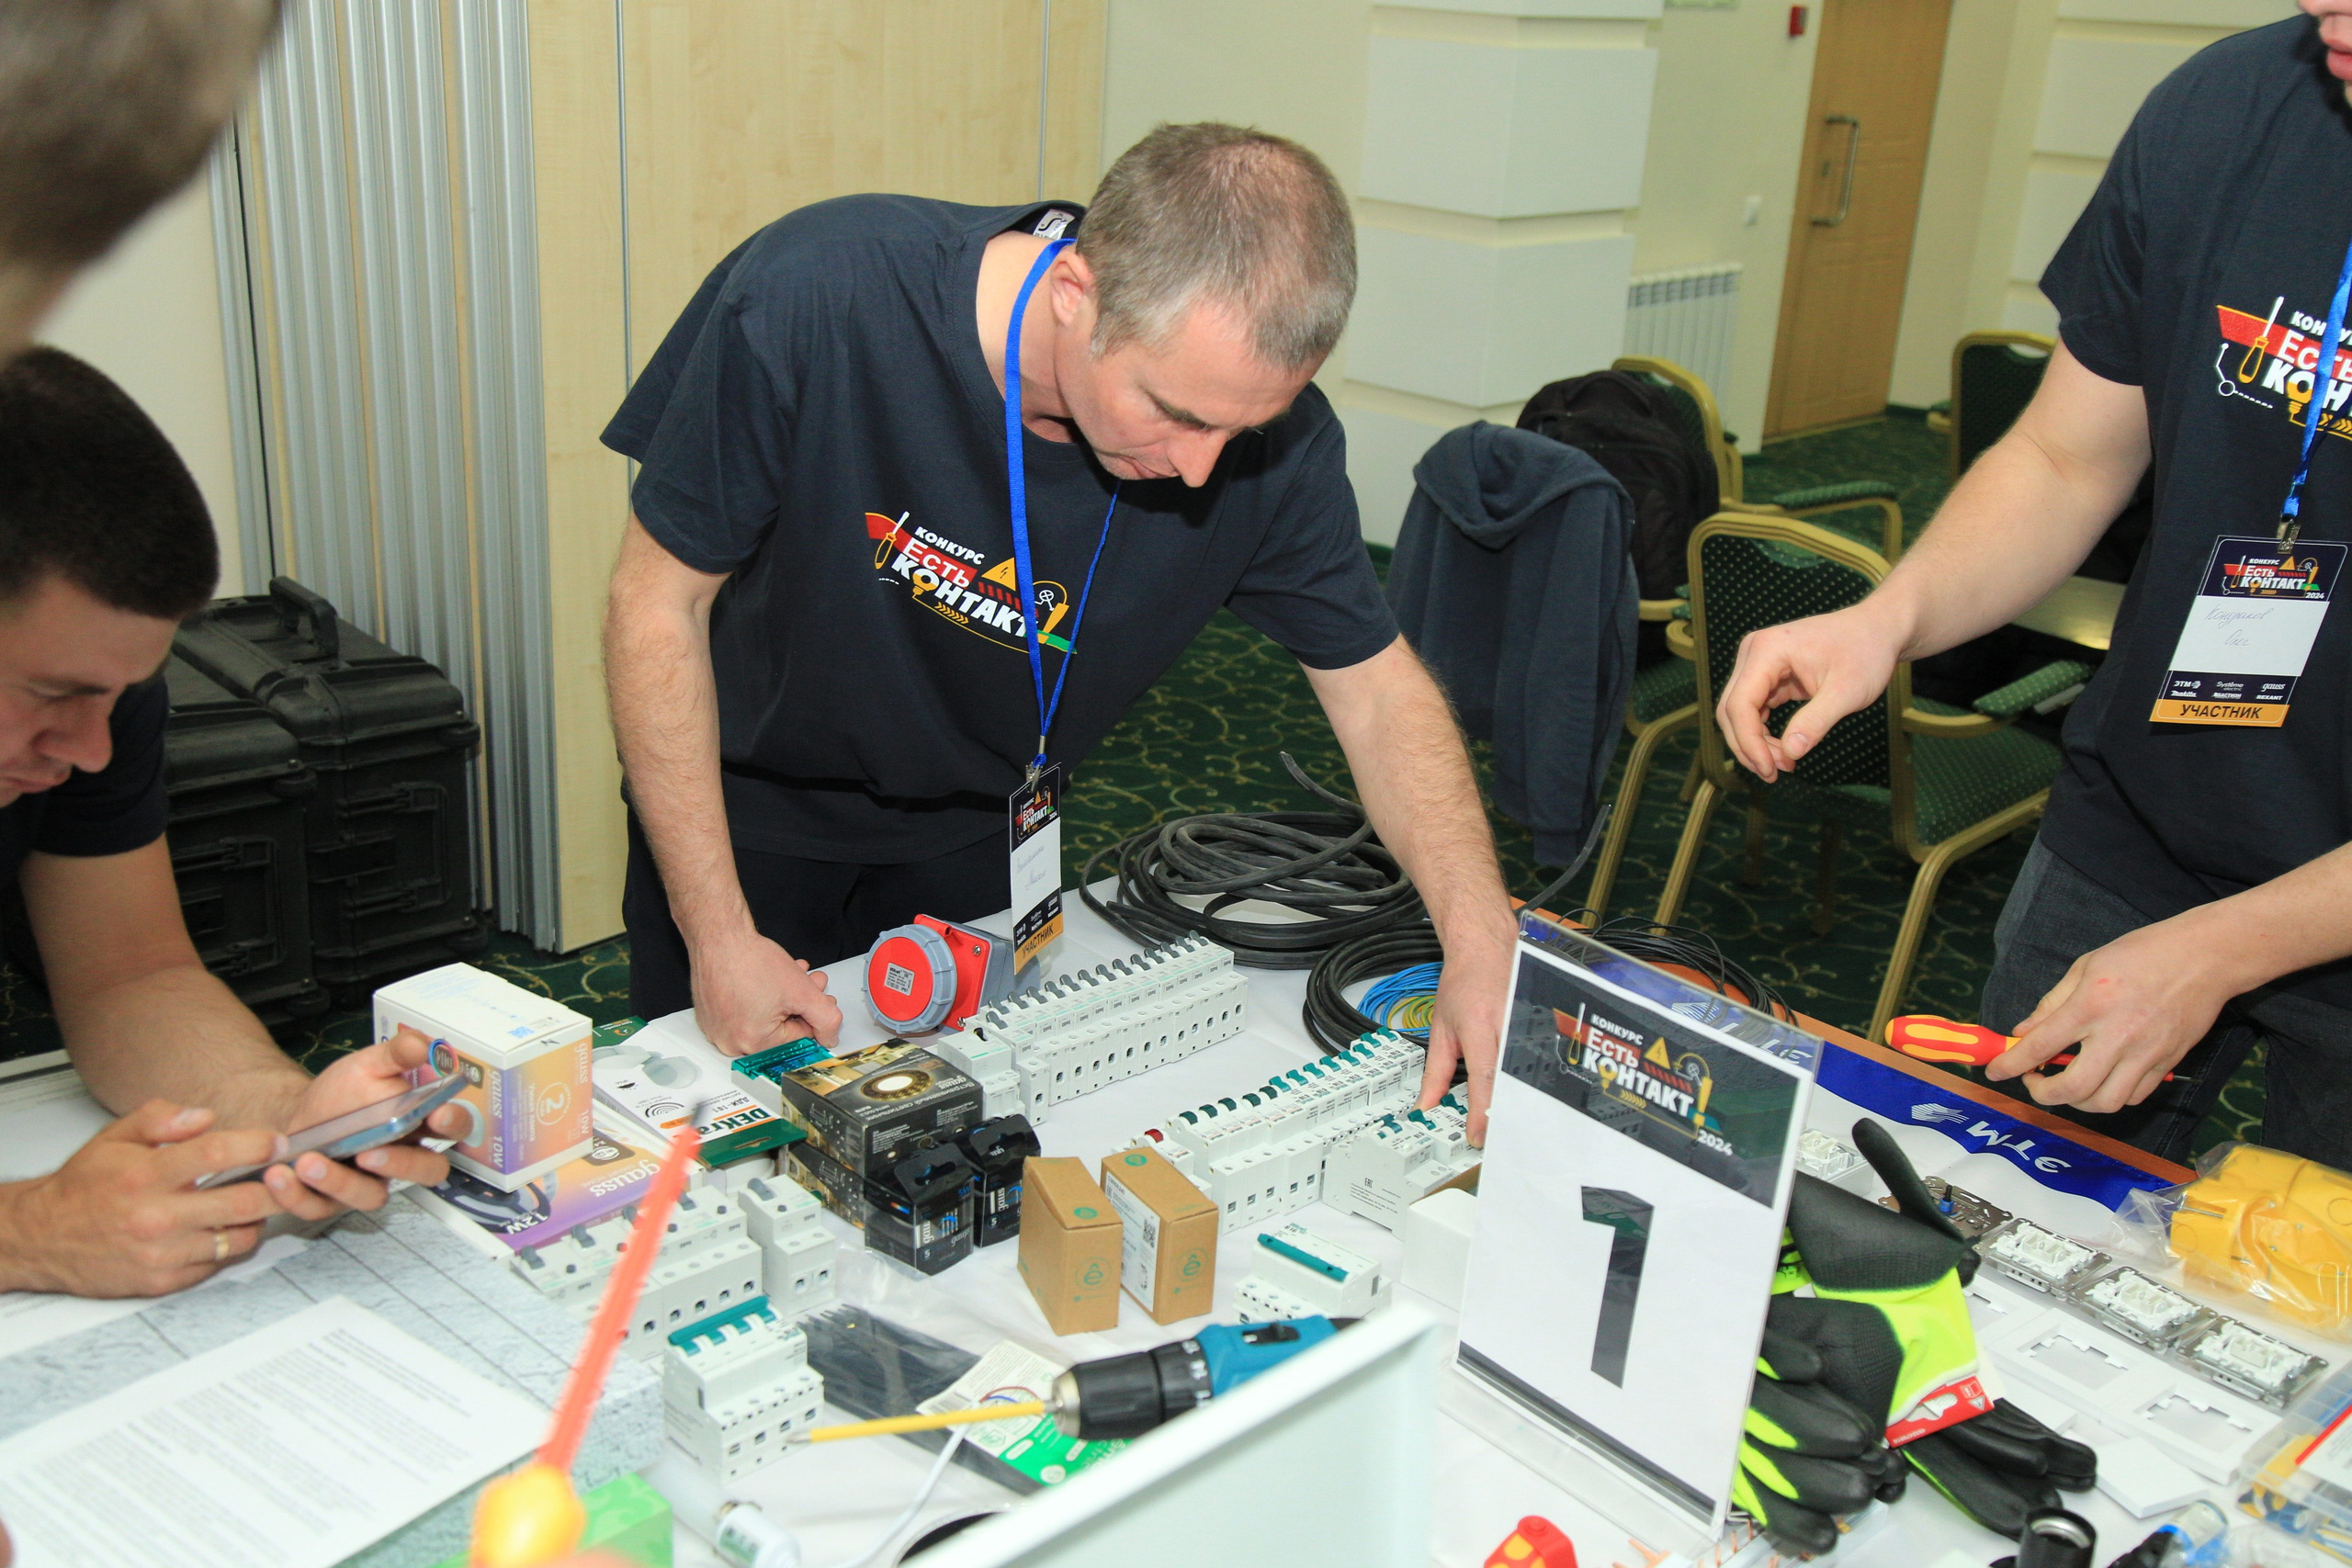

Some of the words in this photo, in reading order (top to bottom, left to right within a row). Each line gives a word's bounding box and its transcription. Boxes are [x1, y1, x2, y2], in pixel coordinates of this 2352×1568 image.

[2290, 310, 2352, 346] КОНУ
[2261, 357, 2352, 417] КОН
[914, 525, 986, 565] КОНКУРС
[2248, 558, 2280, 566] КОНКУРС
[2239, 576, 2307, 590] КОНТАКТ
[2305, 592, 2325, 600] 2024
[2173, 680, 2191, 688] ЭТМ
[2261, 682, 2286, 693] gauss
[2179, 704, 2263, 719] УЧАСТНИК
[1022, 922, 1054, 958] УЧАСТНИК
[1589, 1013, 1645, 1047] КОНКУРС
[575, 1042, 588, 1084] gauss
[488, 1070, 503, 1119] gauss
[938, 1074, 967, 1090] gauss
[1582, 1047, 1695, 1118] КОНТАКТ
[581, 1109, 590, 1135] 10W
[700, 1107, 771, 1138] DEKra
[493, 1135, 504, 1168] 10W
[1697, 1128, 1735, 1156] 2024
[1966, 1119, 2073, 1174] ЭТМ
[590, 1159, 661, 1198] gauss
[506, 1210, 549, 1235] 12W
[1580, 1185, 1656, 1390] 1
